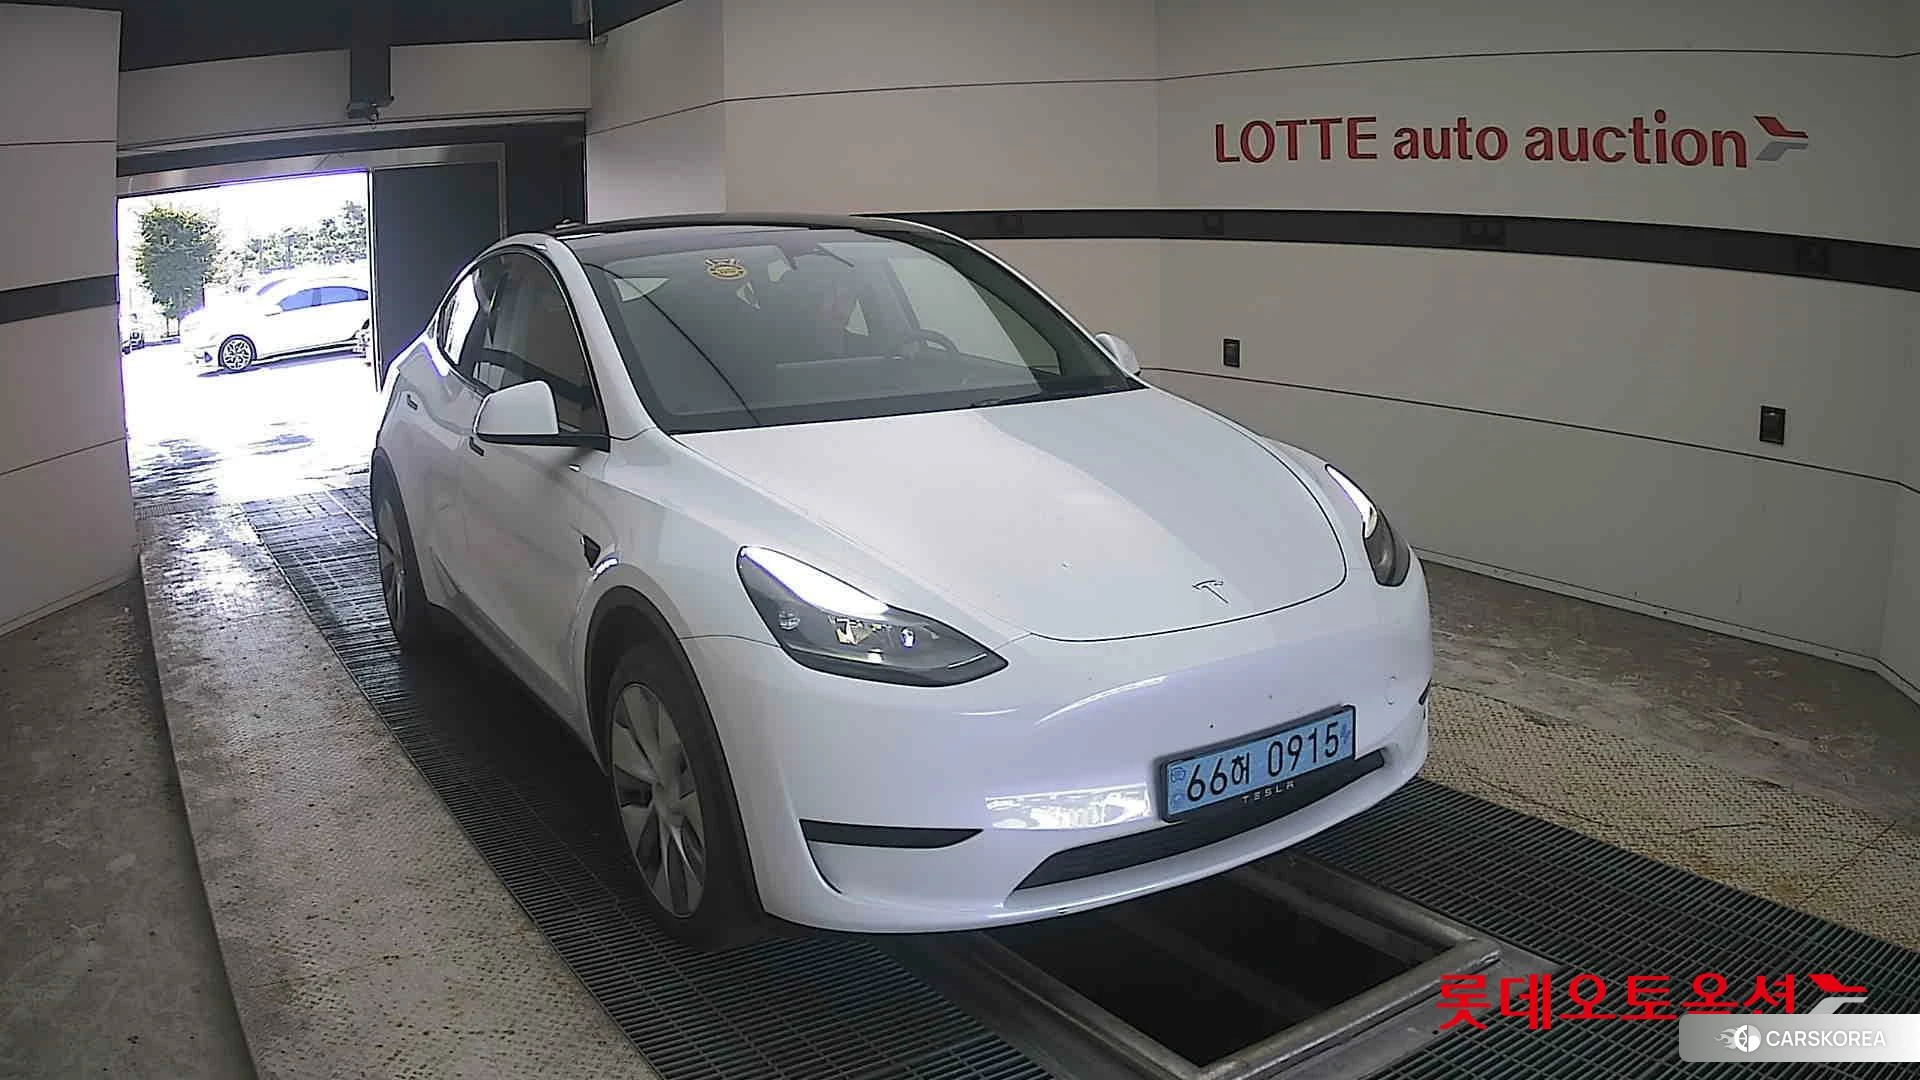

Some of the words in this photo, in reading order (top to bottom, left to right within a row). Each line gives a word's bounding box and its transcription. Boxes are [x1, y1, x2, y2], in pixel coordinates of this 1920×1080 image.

[1215, 117, 1377, 163] LOTTE
[1393, 117, 1509, 160] auto
[1524, 109, 1748, 168] auction
[1187, 751, 1250, 801] 66허
[1267, 722, 1340, 777] 0915
[1241, 781, 1296, 804] TESLA
